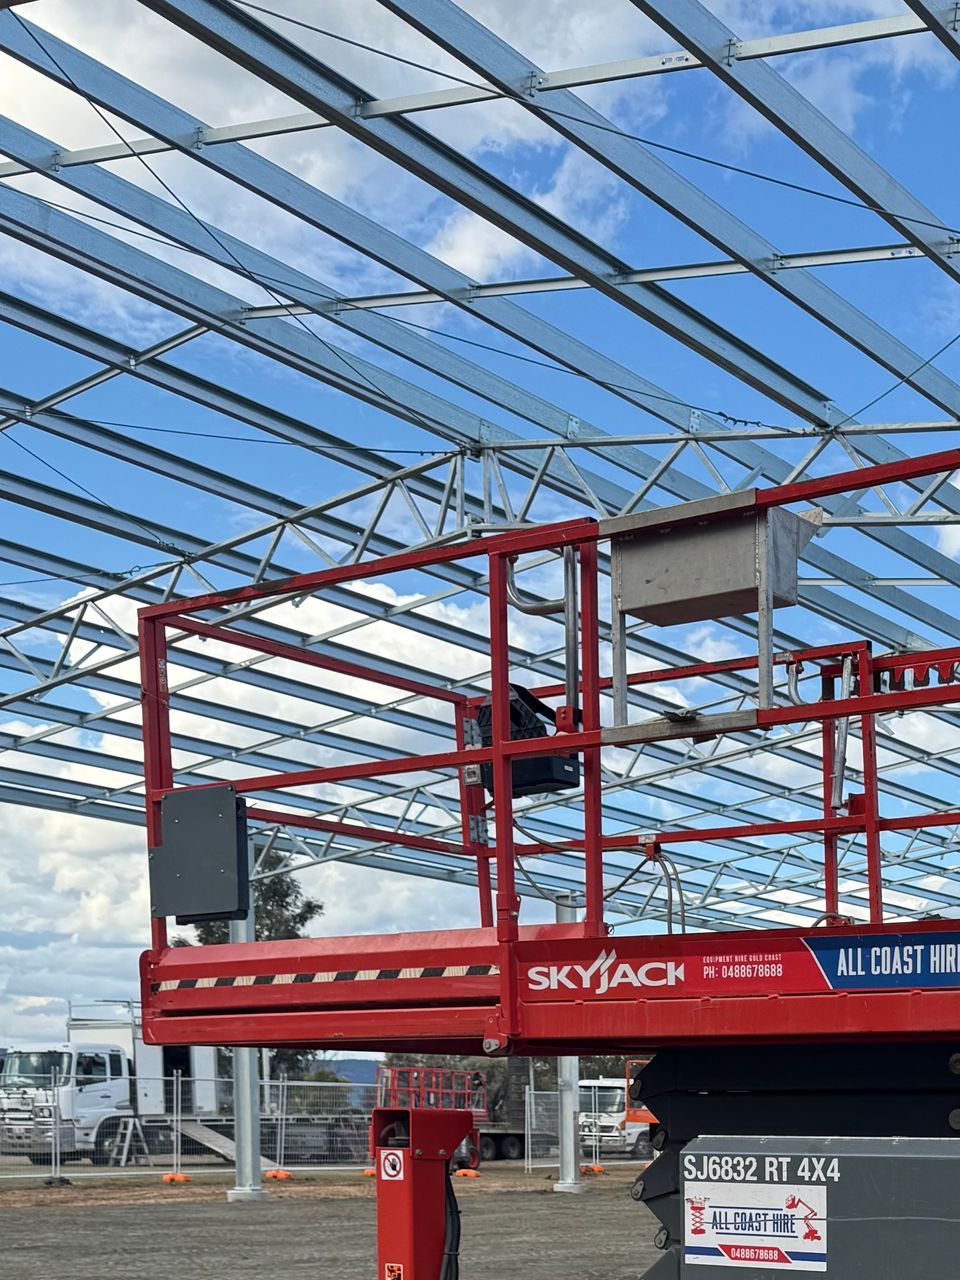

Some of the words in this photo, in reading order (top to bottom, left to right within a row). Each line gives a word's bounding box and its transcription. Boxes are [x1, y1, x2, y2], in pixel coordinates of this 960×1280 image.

[703, 955, 733, 964] EQUIPMENT
[749, 954, 763, 962] GOLD
[764, 953, 782, 962] COAST
[837, 947, 866, 976] ALL
[871, 945, 925, 975] COAST
[527, 948, 685, 995] SKYJACK
[703, 966, 719, 979] PH:
[721, 963, 783, 978] 0488678688
[683, 1154, 758, 1181] SJ6832
[764, 1156, 792, 1182] RT
[797, 1157, 841, 1182] 4X4
[711, 1210, 731, 1231] ALL
[733, 1211, 769, 1233] COAST
[772, 1213, 796, 1234] HIRE
[730, 1247, 779, 1261] 0488678688
